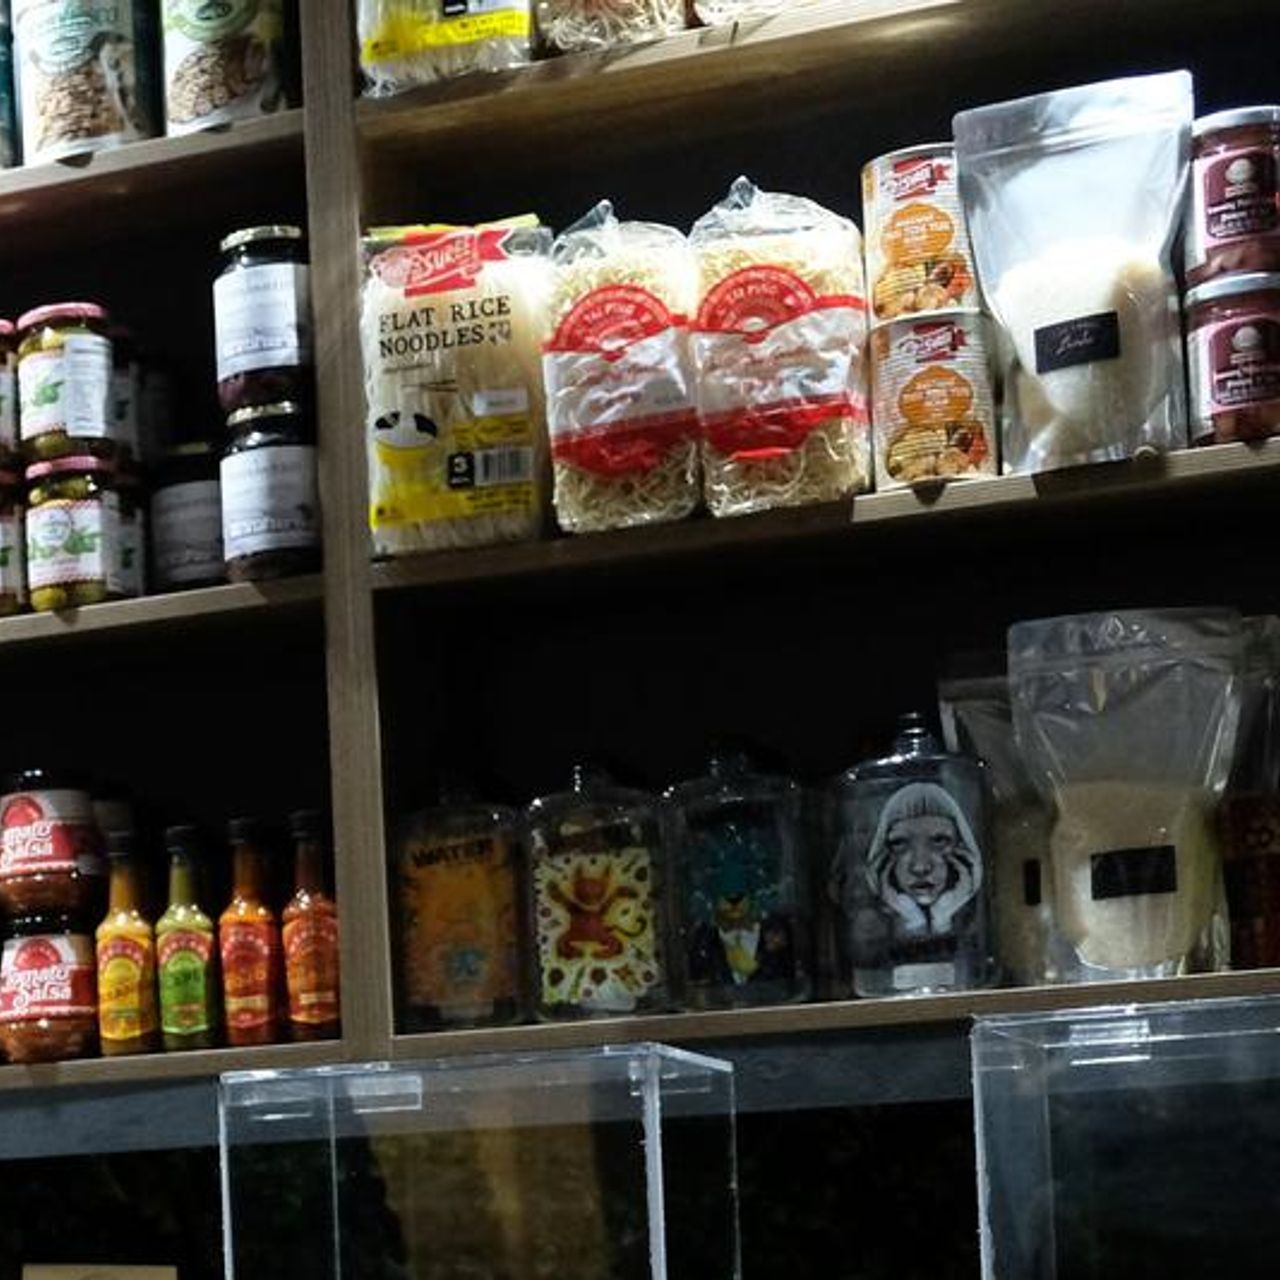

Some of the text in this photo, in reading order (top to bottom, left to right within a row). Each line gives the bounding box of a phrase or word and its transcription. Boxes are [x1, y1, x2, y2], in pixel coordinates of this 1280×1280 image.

[380, 295, 511, 333] FLAT RICE
[379, 324, 485, 358] NOODLES
[13, 982, 73, 1013] Salsa
